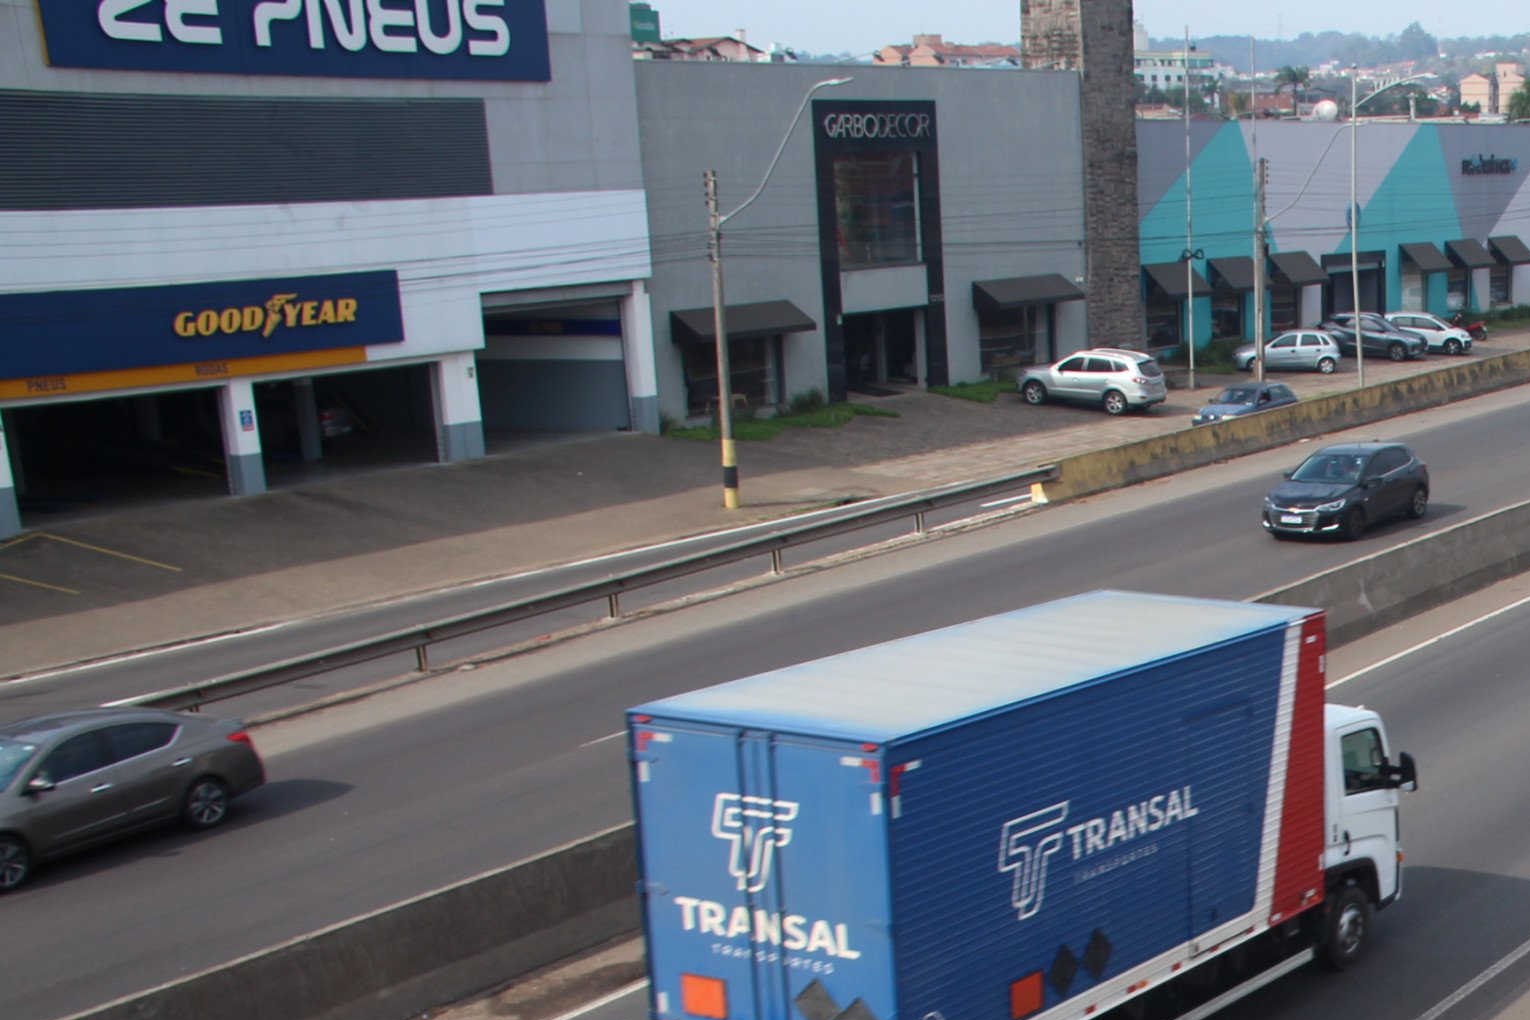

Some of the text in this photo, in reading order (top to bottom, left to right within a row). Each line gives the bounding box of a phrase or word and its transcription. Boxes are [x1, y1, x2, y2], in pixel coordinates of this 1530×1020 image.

[254, 0, 511, 56] PNEUS
[27, 377, 67, 393] PNEUS
[1066, 785, 1199, 860] TRANSAL
[673, 896, 862, 960] TRANSAL
